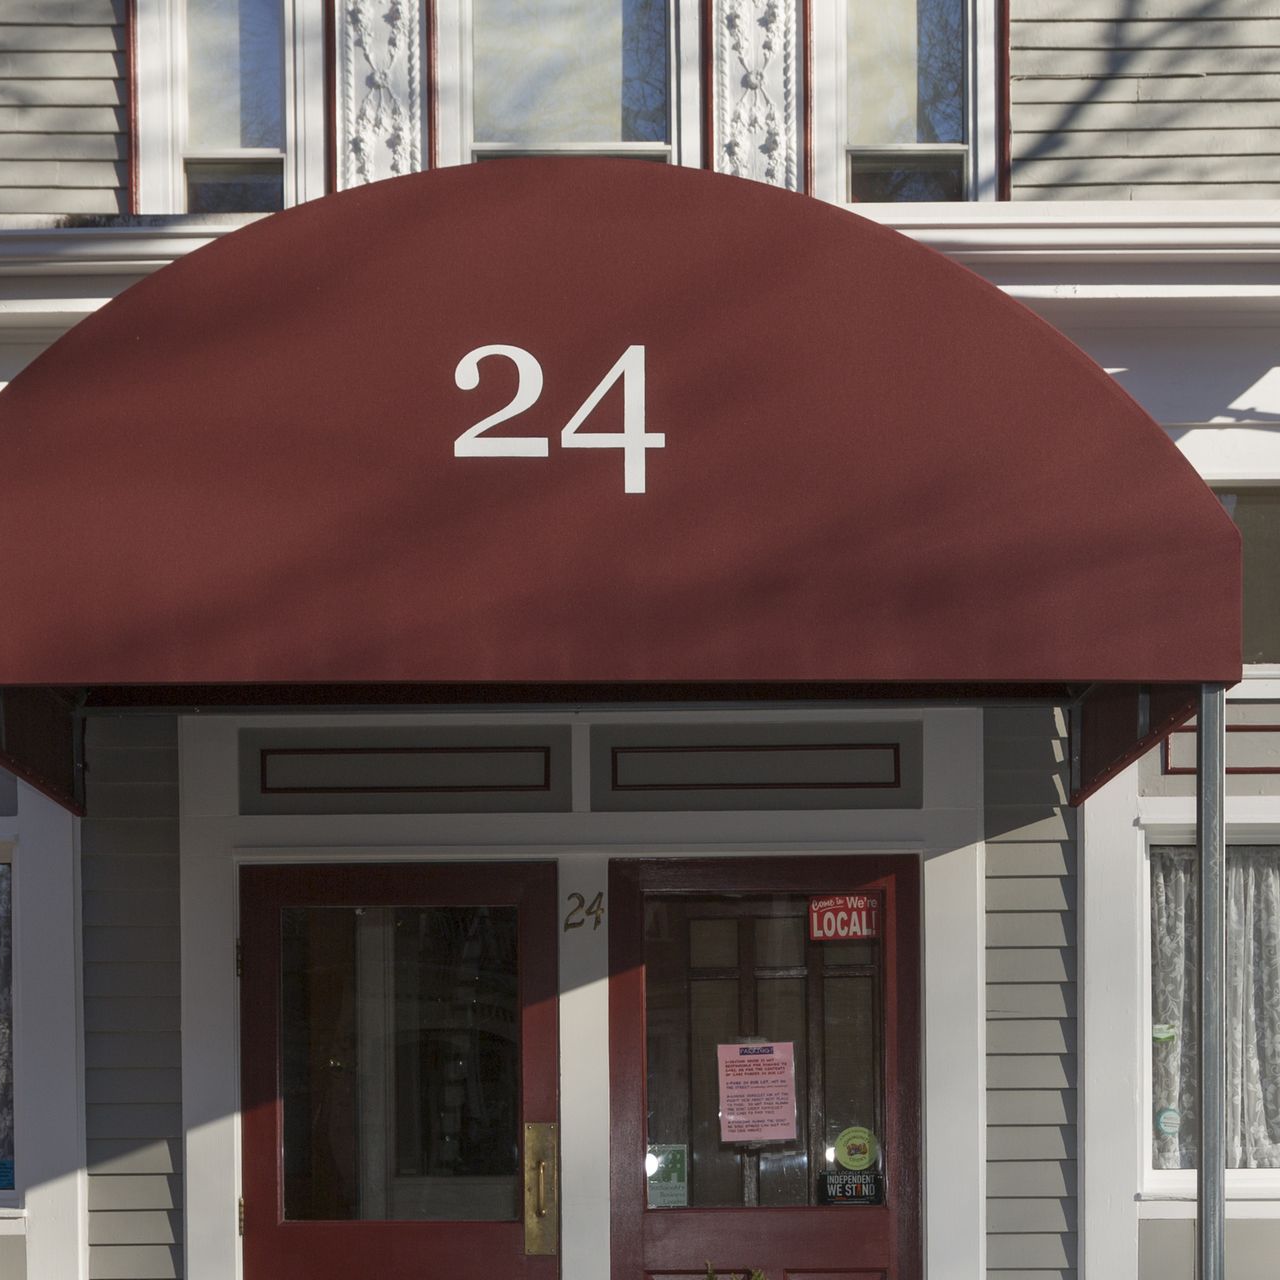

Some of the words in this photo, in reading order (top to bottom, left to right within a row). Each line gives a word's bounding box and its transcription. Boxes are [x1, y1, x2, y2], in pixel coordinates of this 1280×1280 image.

[453, 344, 666, 494] 24
[563, 891, 604, 932] 24
[811, 899, 835, 911] Come
[846, 896, 878, 909] We're
[812, 910, 877, 937] LOCAL!
[826, 1175, 875, 1184] INDEPENDENT
[827, 1184, 842, 1196] WE
